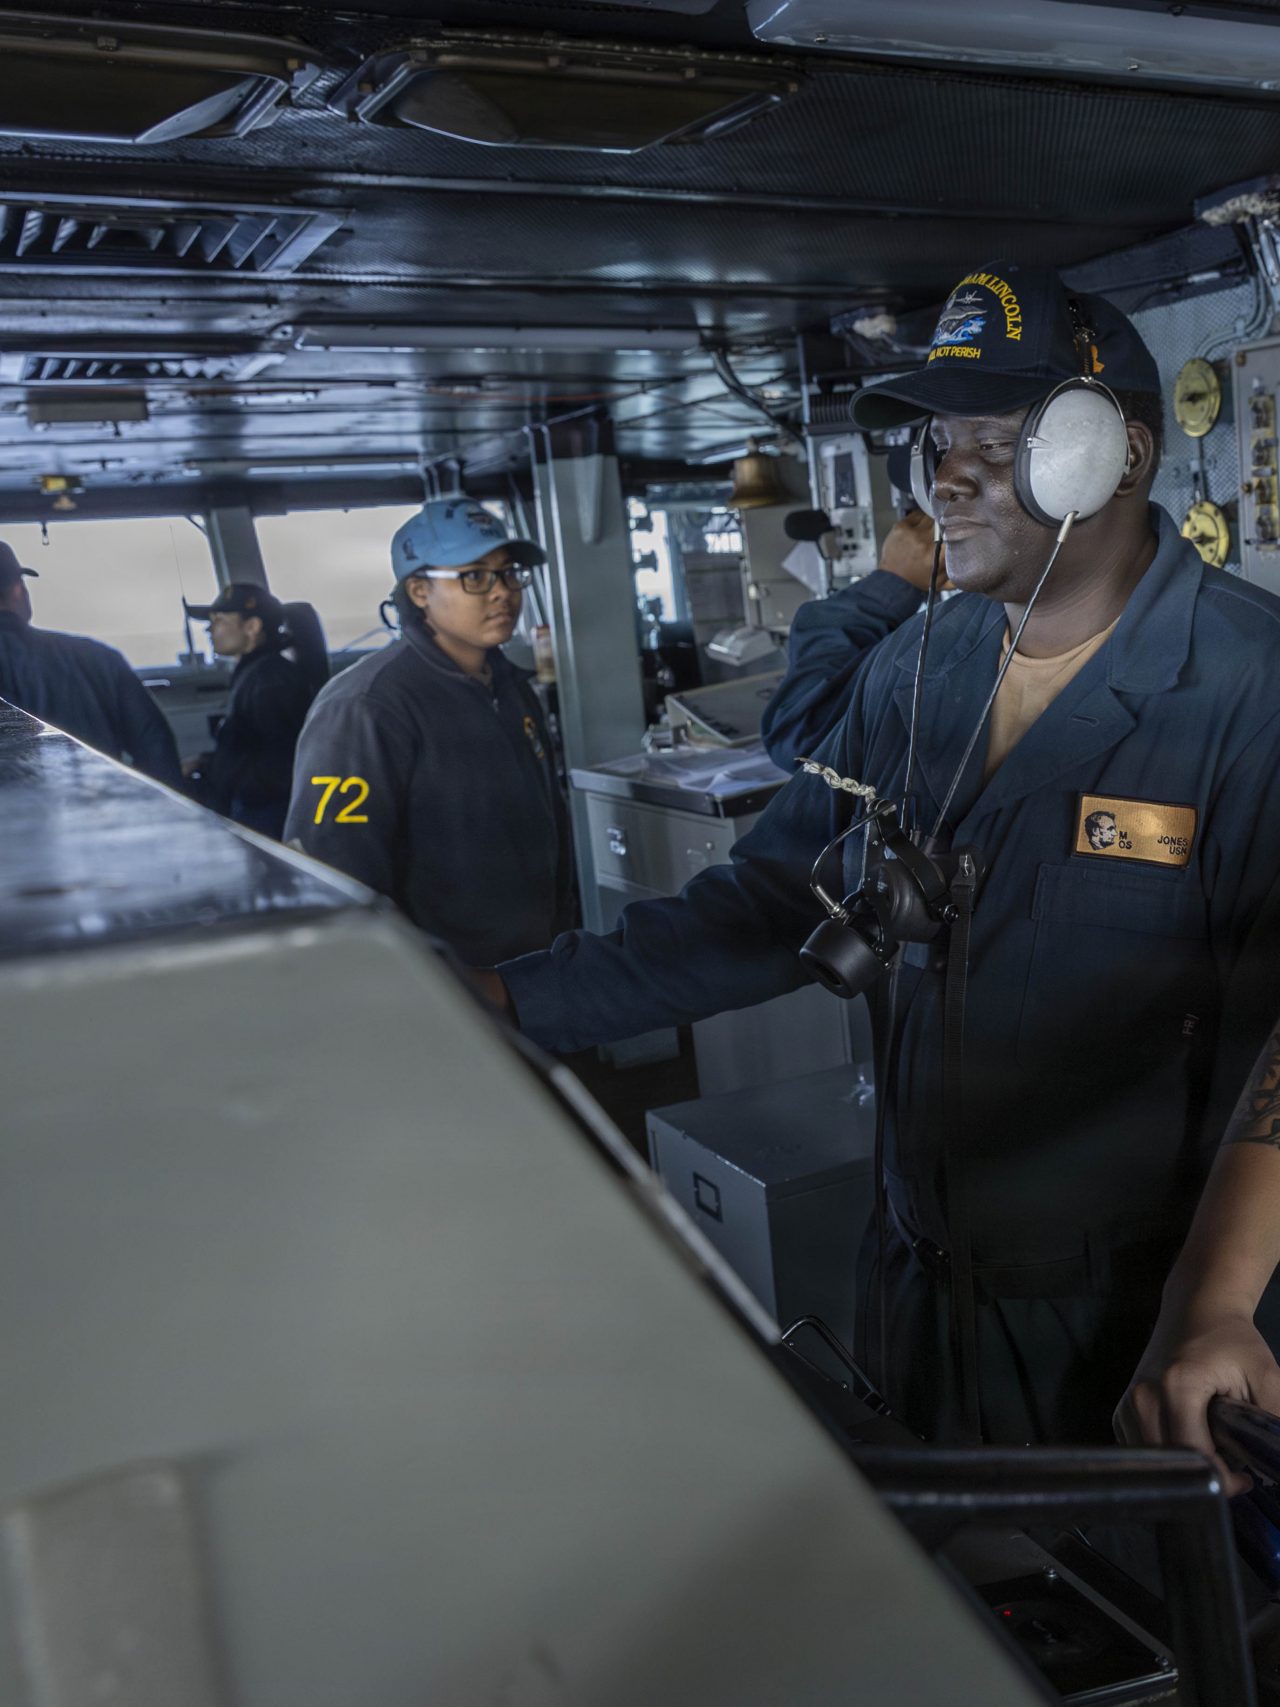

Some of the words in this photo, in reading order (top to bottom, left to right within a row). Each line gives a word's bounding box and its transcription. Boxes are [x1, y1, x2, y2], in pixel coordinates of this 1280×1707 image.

[985, 274, 1023, 341] LINCOLN
[950, 346, 981, 359] PERISH
[311, 776, 369, 825] 72
[1119, 831, 1128, 840] M
[1157, 836, 1188, 847] JONES
[1118, 840, 1133, 850] OS
[1169, 846, 1188, 856] USN
